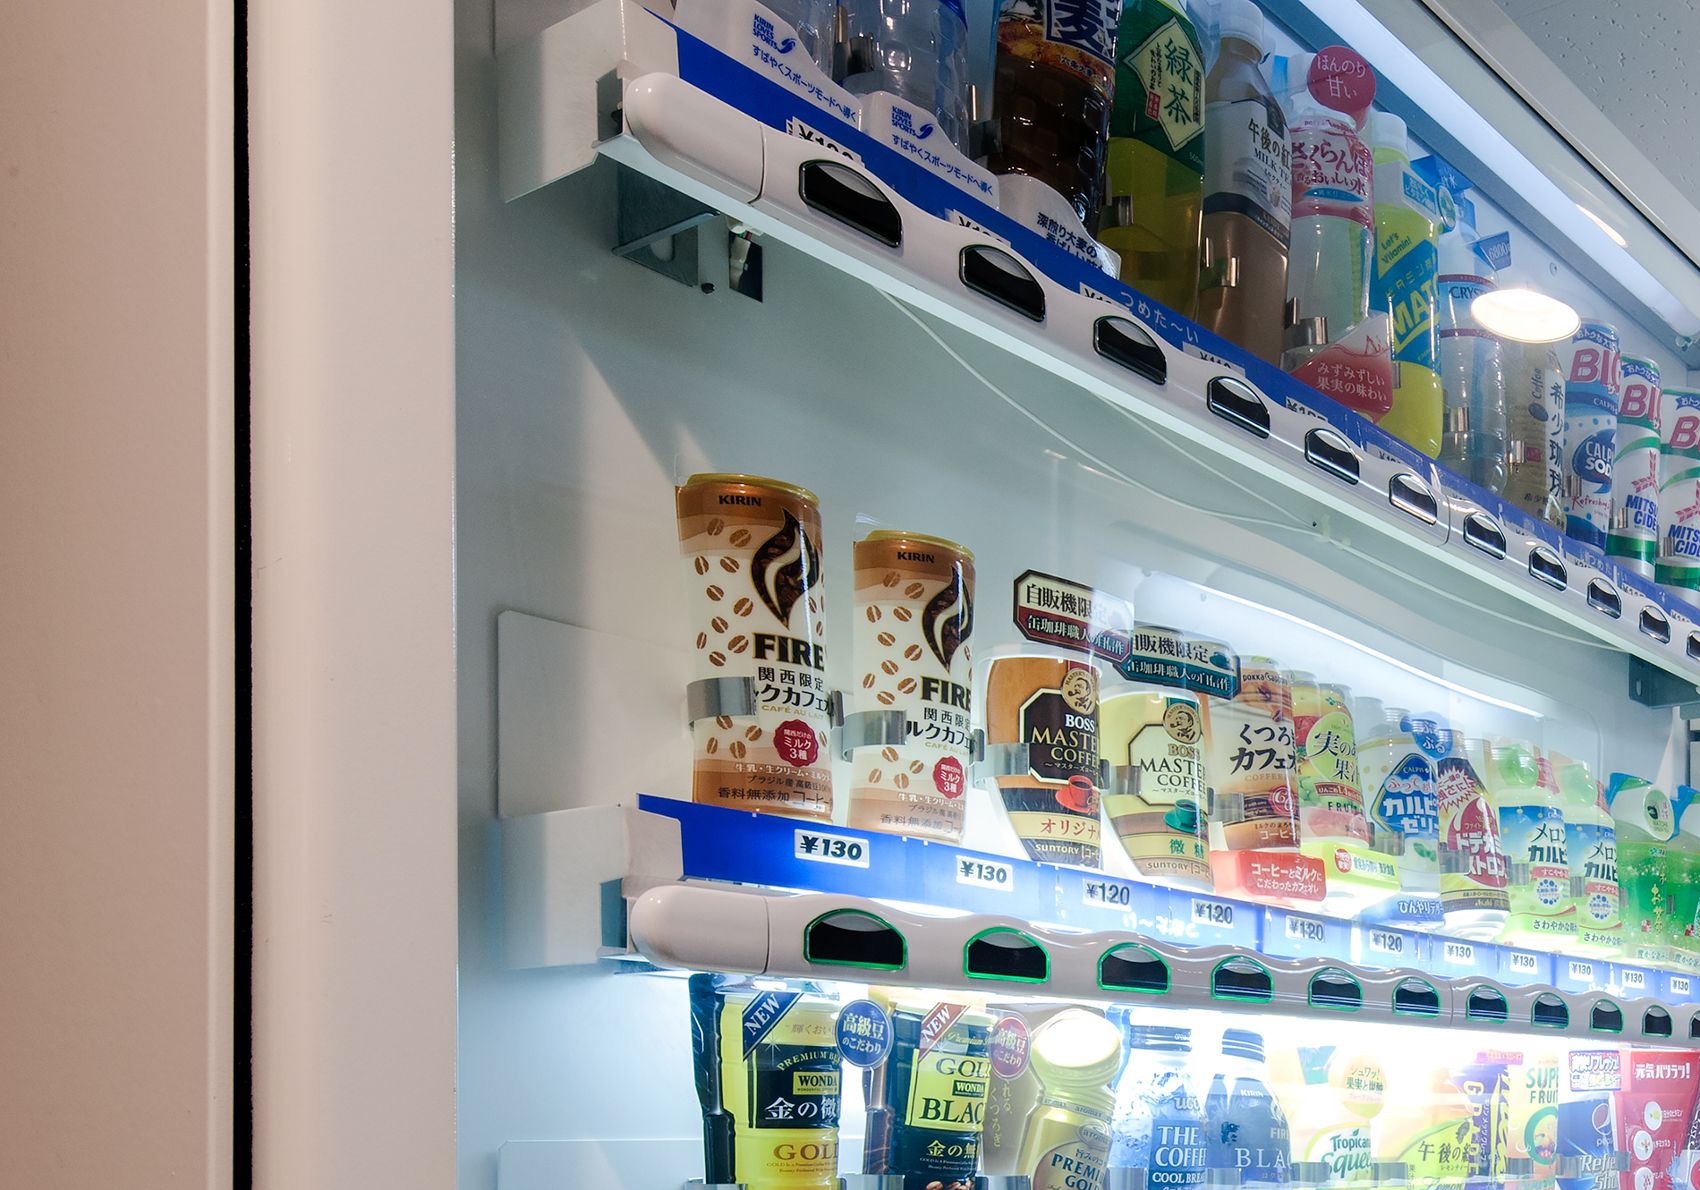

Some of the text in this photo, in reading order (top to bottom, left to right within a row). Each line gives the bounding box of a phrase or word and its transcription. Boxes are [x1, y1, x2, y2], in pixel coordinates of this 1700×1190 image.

[753, 22, 775, 40] LOVES
[754, 14, 774, 32] KIRIN
[752, 29, 777, 50] SPORTS
[1317, 55, 1366, 79] ほんのり
[1164, 38, 1193, 125] 緑茶
[1327, 75, 1357, 98] 甘い
[1037, 212, 1098, 259] 深煎り大麦の
[1317, 362, 1385, 385] みずみずしい
[1317, 377, 1387, 402] 果実の味わい
[718, 495, 761, 507] KIRIN
[897, 552, 934, 564] KIRIN
[1026, 584, 1108, 621] 自販機限
[758, 667, 823, 692] 関西限定
[1065, 714, 1095, 733] BOSS
[784, 736, 811, 750] ミルク
[1031, 727, 1097, 753] MASTE
[1051, 747, 1098, 768] COFFE
[1041, 819, 1100, 839] オリジナ
[800, 835, 862, 861] ¥130
[960, 860, 1008, 885] ¥130
[1085, 881, 1130, 906] ¥120
[1194, 900, 1233, 926] ¥120
[1289, 916, 1324, 941] ¥120
[1373, 934, 1402, 952] ¥120
[1447, 945, 1471, 958] ¥130
[1512, 955, 1534, 968] ¥130
[1571, 963, 1591, 976] ¥130
[1624, 972, 1643, 984] ¥130
[1672, 979, 1689, 991] ¥130
[744, 994, 780, 1036] NEW
[920, 1005, 950, 1042] NEW
[842, 1013, 885, 1041] 高級豆
[842, 1036, 881, 1053] のこだわり
[1635, 1062, 1690, 1079] 元気ハツラツ!
[1240, 1089, 1264, 1097] KIRIN
[765, 1096, 840, 1119] 金の微
[1157, 1126, 1200, 1146] THE
[1051, 1153, 1103, 1182] PREMI
[1152, 1172, 1185, 1183] COOL
